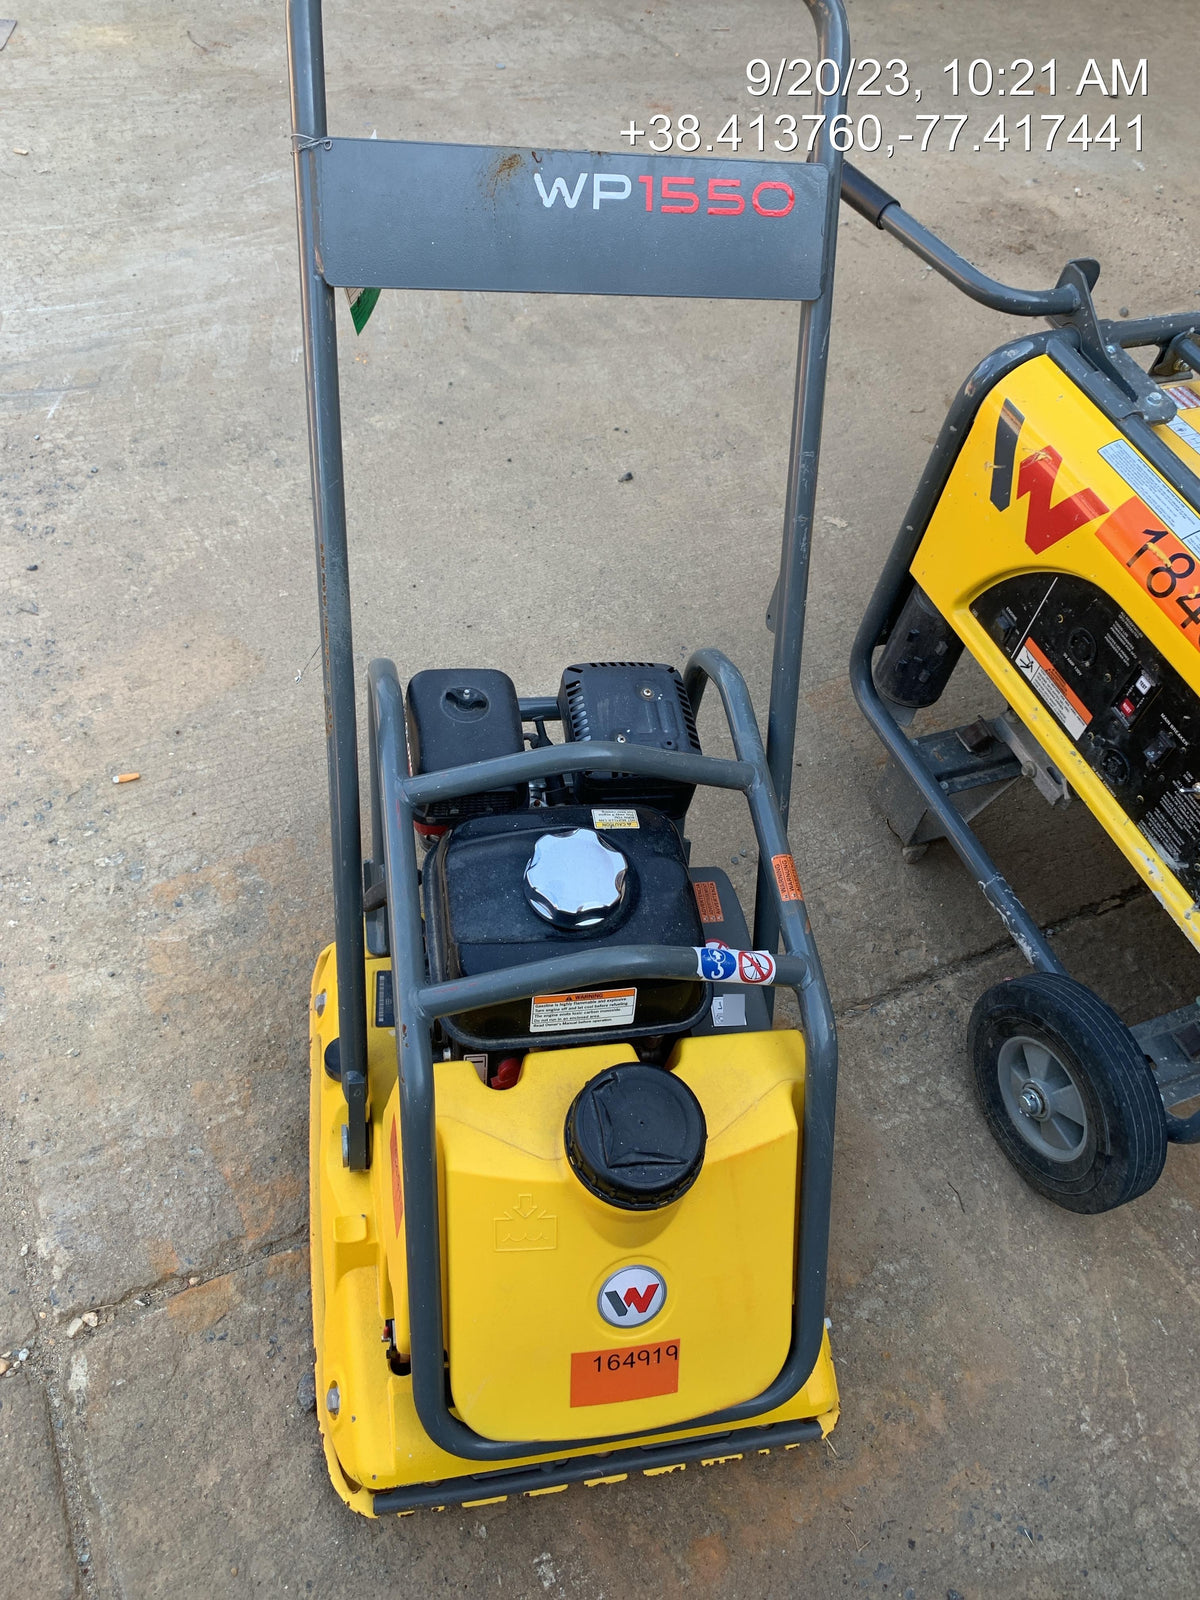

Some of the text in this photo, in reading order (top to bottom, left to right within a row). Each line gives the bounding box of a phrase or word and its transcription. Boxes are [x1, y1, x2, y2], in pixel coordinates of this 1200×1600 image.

[534, 172, 795, 218] WP1550
[1126, 529, 1200, 648] 184
[593, 1345, 678, 1372] 164919
